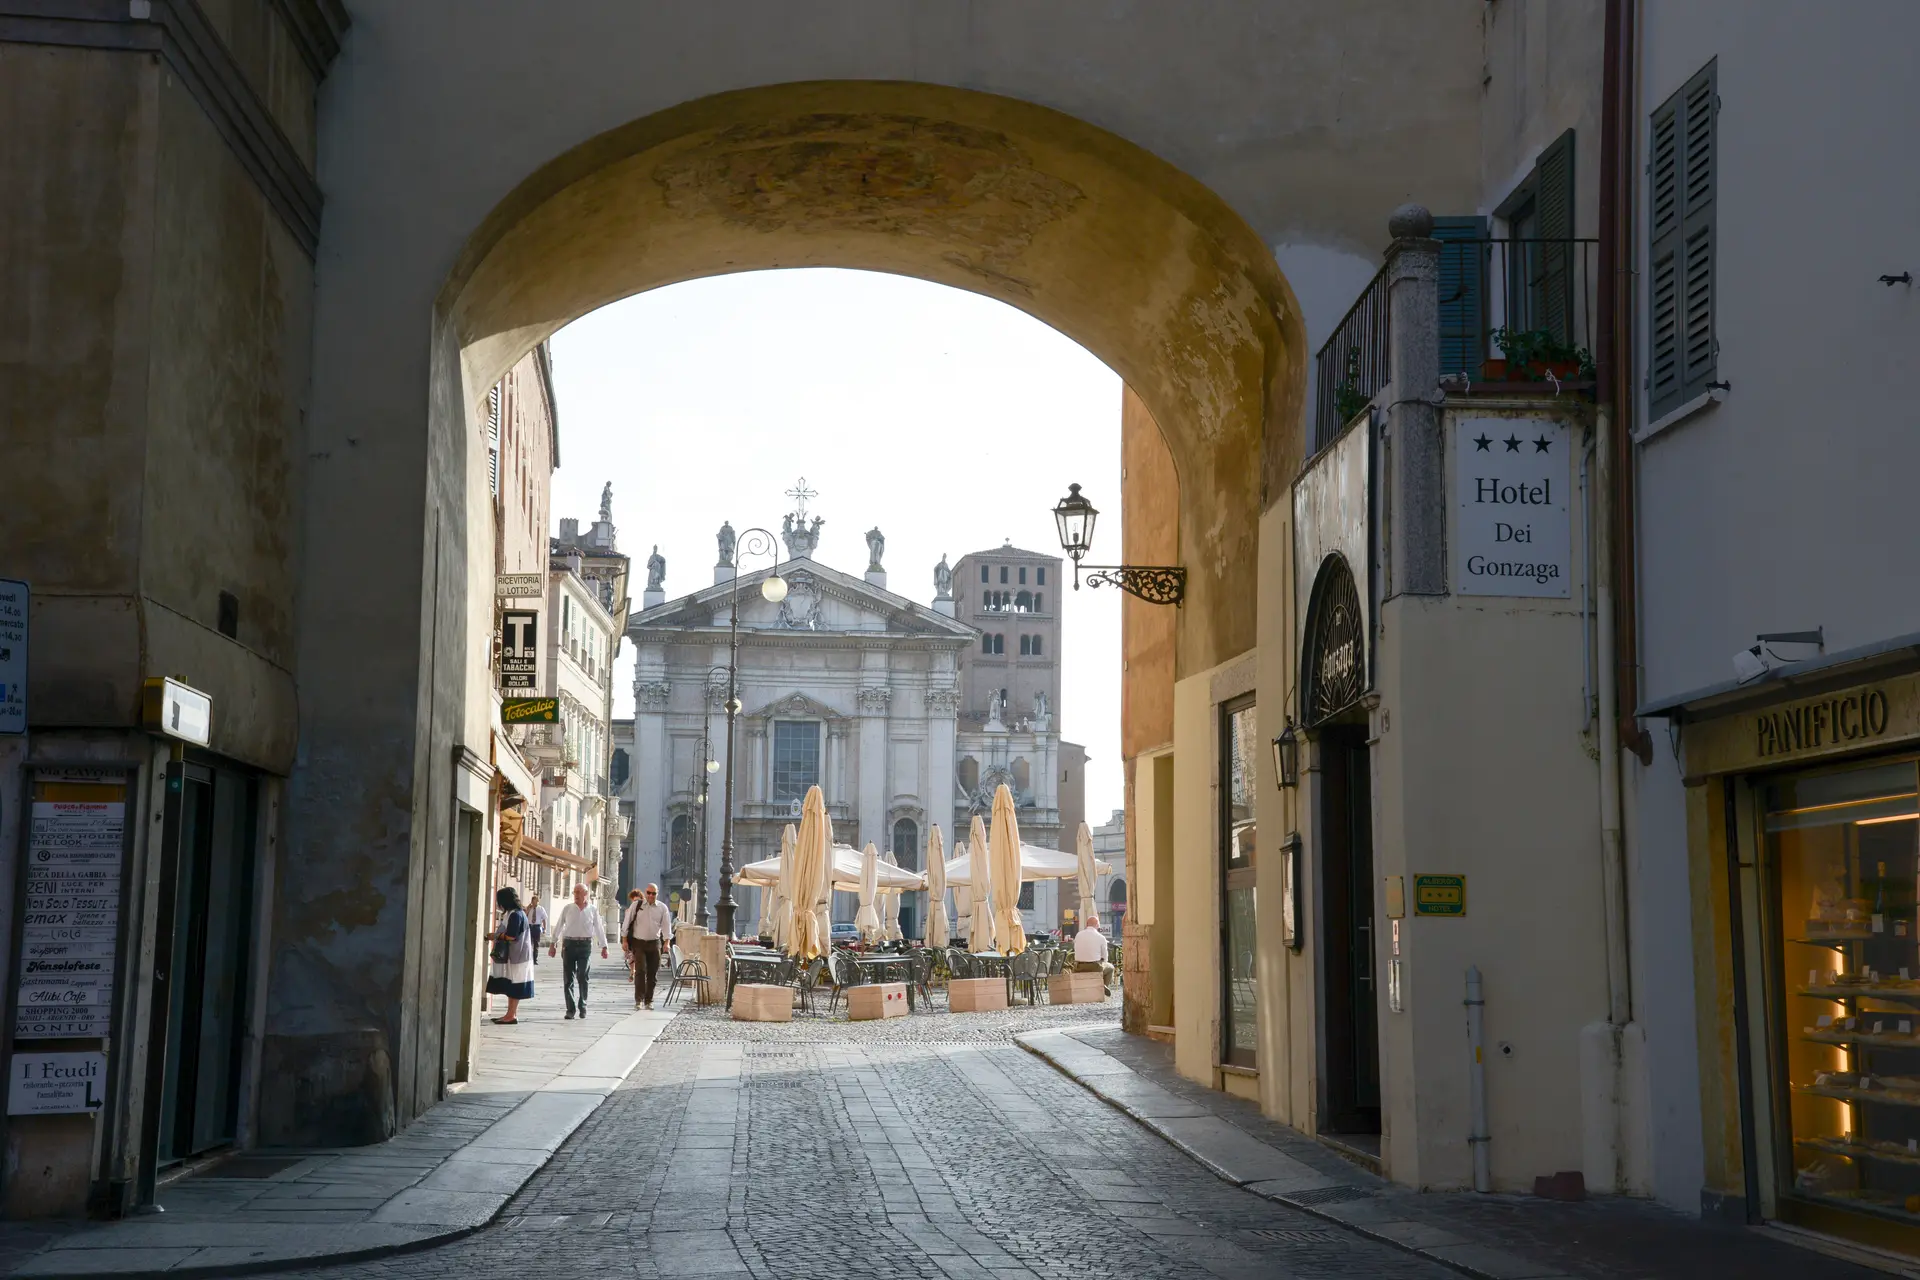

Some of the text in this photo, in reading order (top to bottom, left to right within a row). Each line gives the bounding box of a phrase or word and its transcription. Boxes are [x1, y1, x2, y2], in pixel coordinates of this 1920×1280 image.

[1474, 477, 1551, 505] Hotel
[1494, 522, 1532, 543] Dei
[1467, 555, 1560, 584] Gonzaga
[498, 576, 540, 585] RICEVITORIA
[507, 586, 529, 595] LOTTO
[507, 616, 533, 658] T
[504, 700, 556, 721] Totocalcio
[1757, 689, 1888, 758] PANIFICIO
[51, 871, 76, 879] DELLA
[78, 871, 107, 879] GABBIA
[27, 881, 58, 894] ZENI
[25, 914, 68, 925] emax
[26, 961, 101, 973] Nonsolofeste
[20, 977, 69, 988] Gastronomia
[29, 991, 61, 1003] Alibi
[25, 1007, 69, 1015] SHOPPING
[42, 1061, 98, 1079] Feudi
